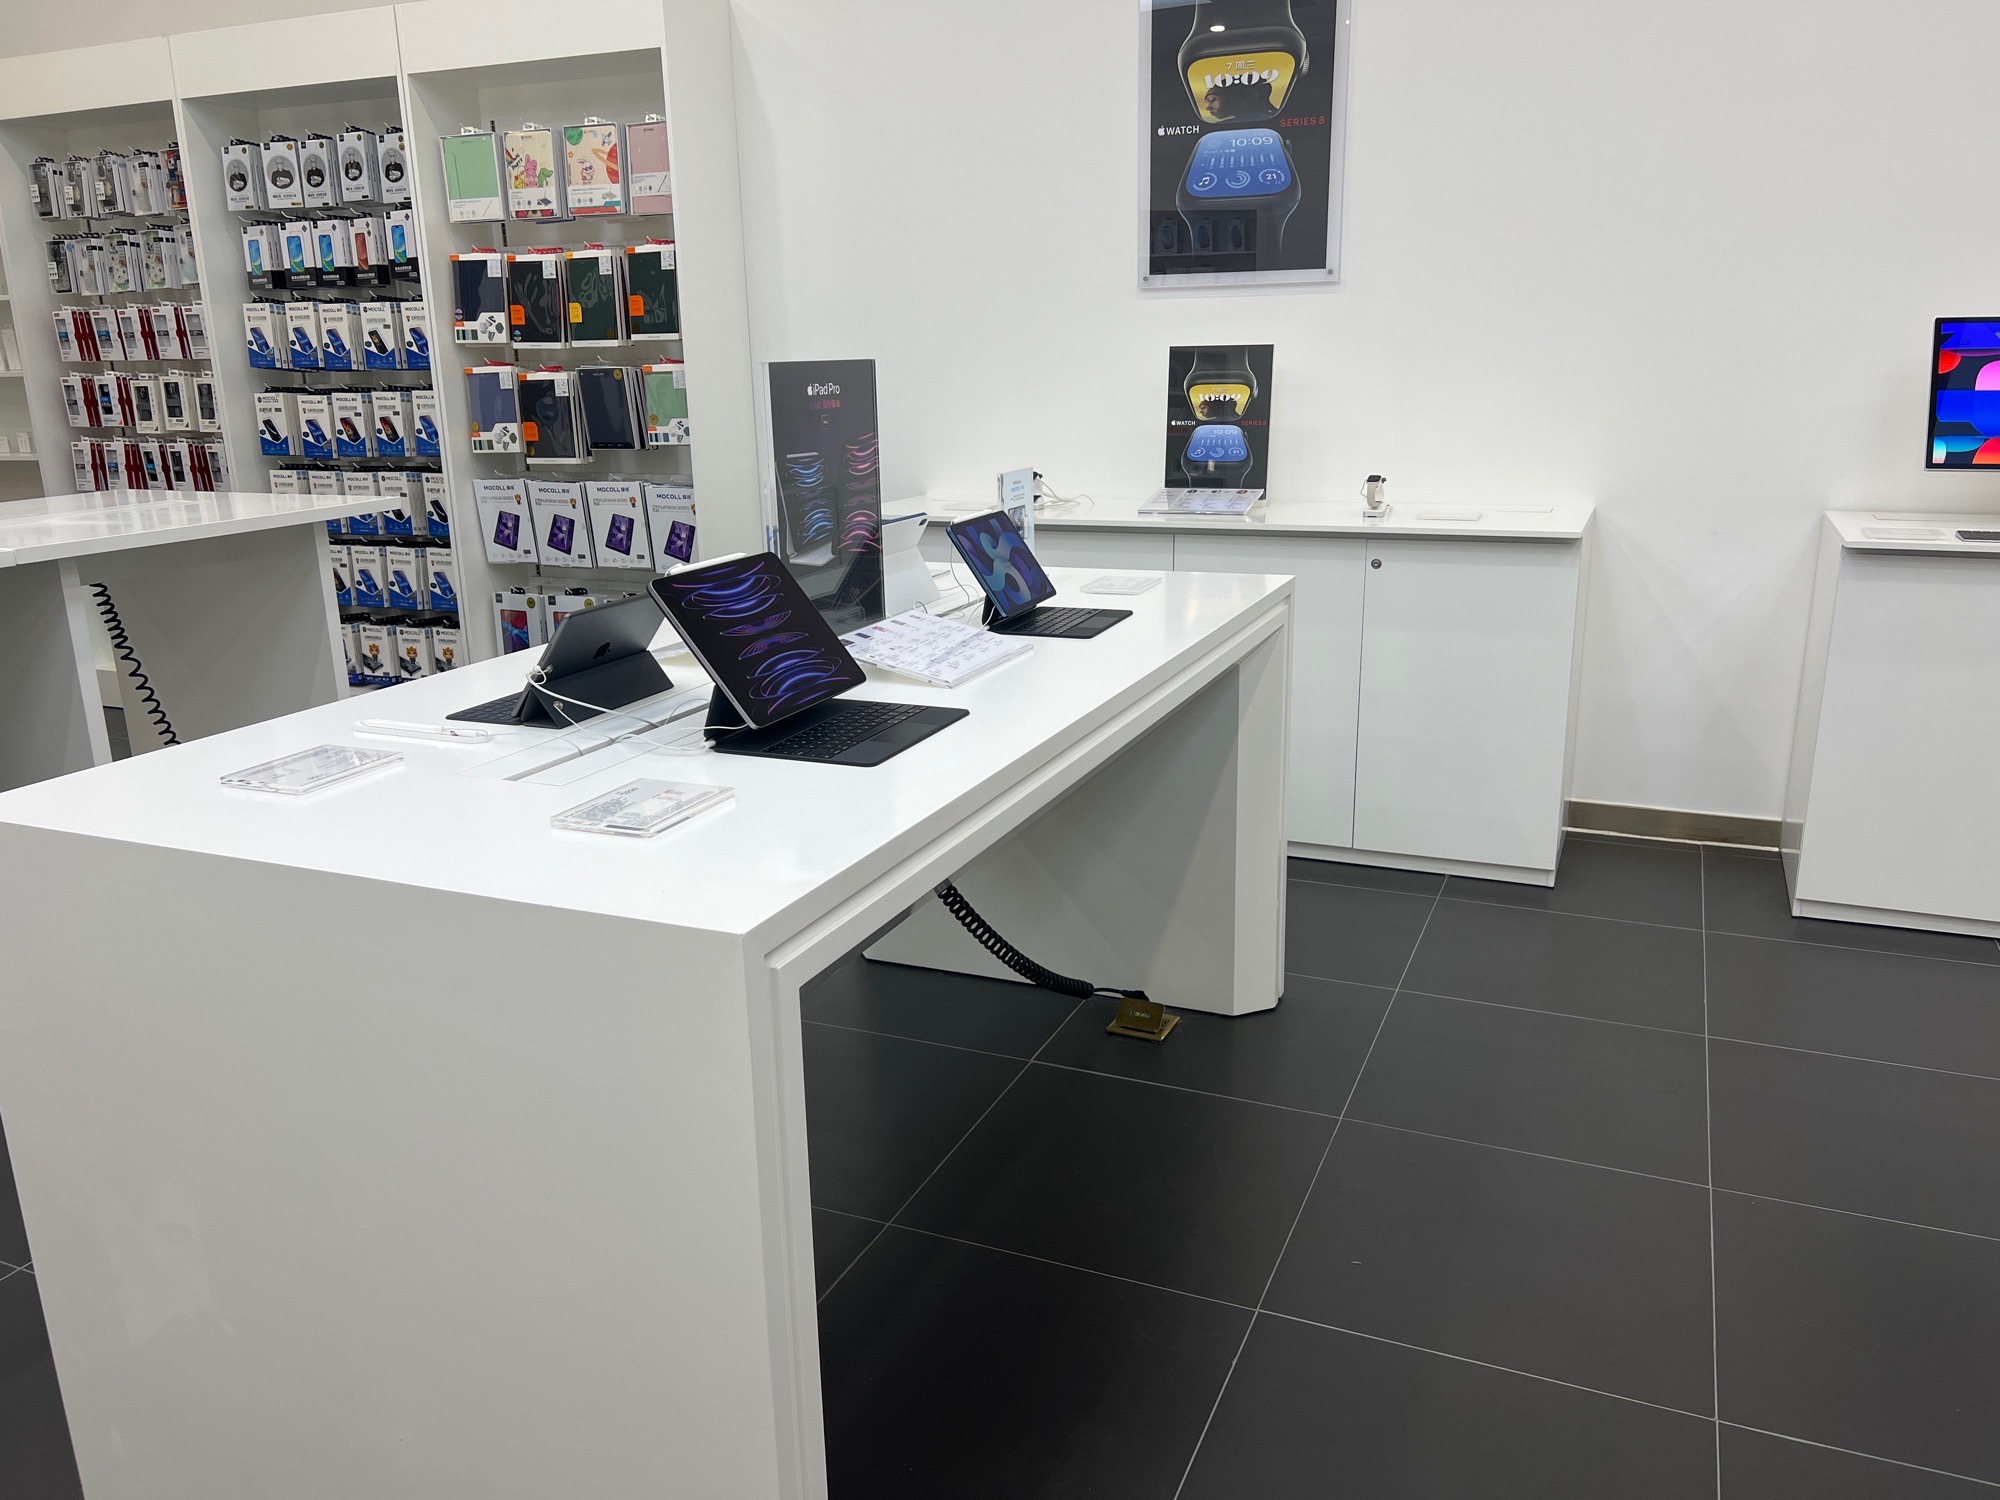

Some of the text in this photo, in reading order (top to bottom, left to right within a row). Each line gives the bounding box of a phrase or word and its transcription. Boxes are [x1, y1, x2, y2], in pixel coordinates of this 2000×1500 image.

[1226, 60, 1256, 70] 7 周三
[1203, 69, 1279, 89] 10:09
[1280, 116, 1325, 128] SERIES 8
[1166, 125, 1200, 136] WATCH
[1229, 136, 1273, 147] 10:09
[812, 382, 841, 396] iPad Pro
[1199, 393, 1241, 402] 10:09
